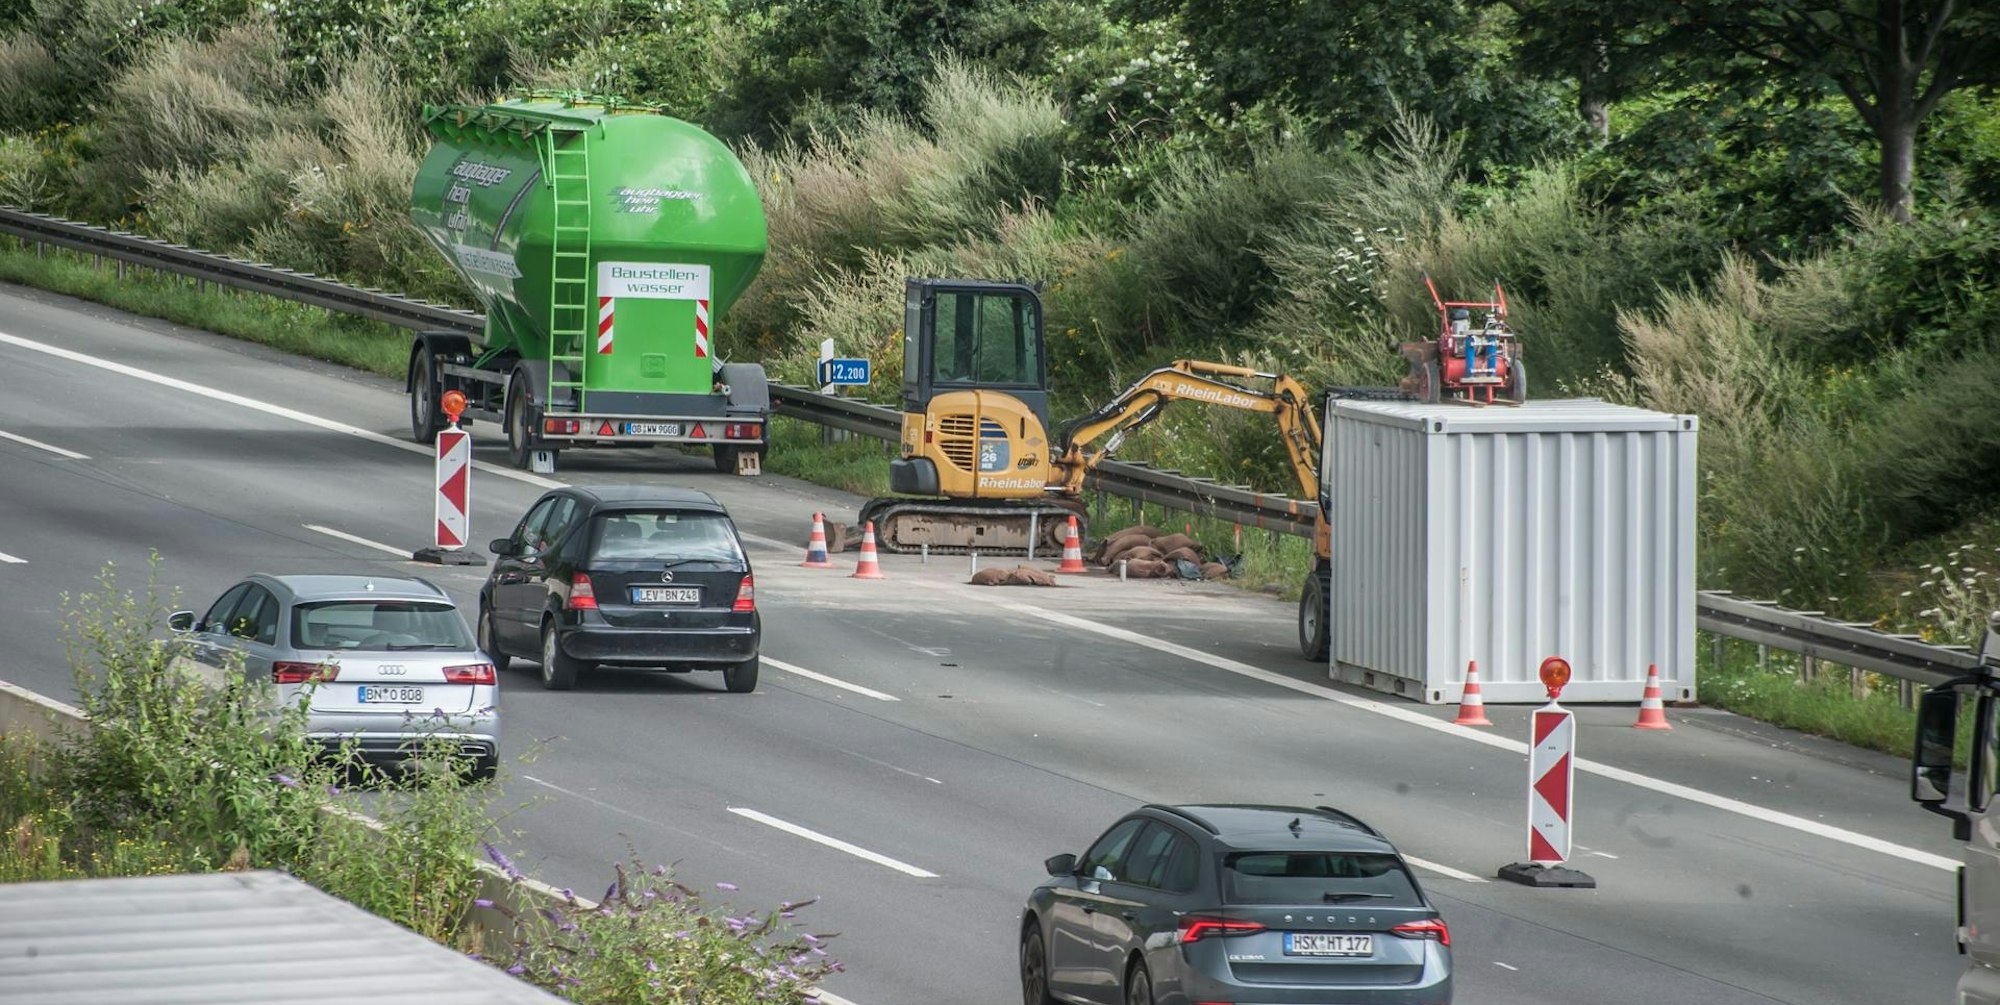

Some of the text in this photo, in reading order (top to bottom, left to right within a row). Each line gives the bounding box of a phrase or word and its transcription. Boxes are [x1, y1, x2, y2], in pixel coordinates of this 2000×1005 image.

[611, 266, 699, 280] Baustellen-
[627, 283, 685, 293] wasser
[1175, 383, 1257, 408] RheinLabor
[981, 452, 997, 462] 26
[979, 476, 1046, 489] RheinLabor
[640, 590, 698, 601] LEV BN 248
[366, 688, 382, 700] BN
[400, 689, 422, 701] 808
[1293, 935, 1371, 951] HSK HT 177
